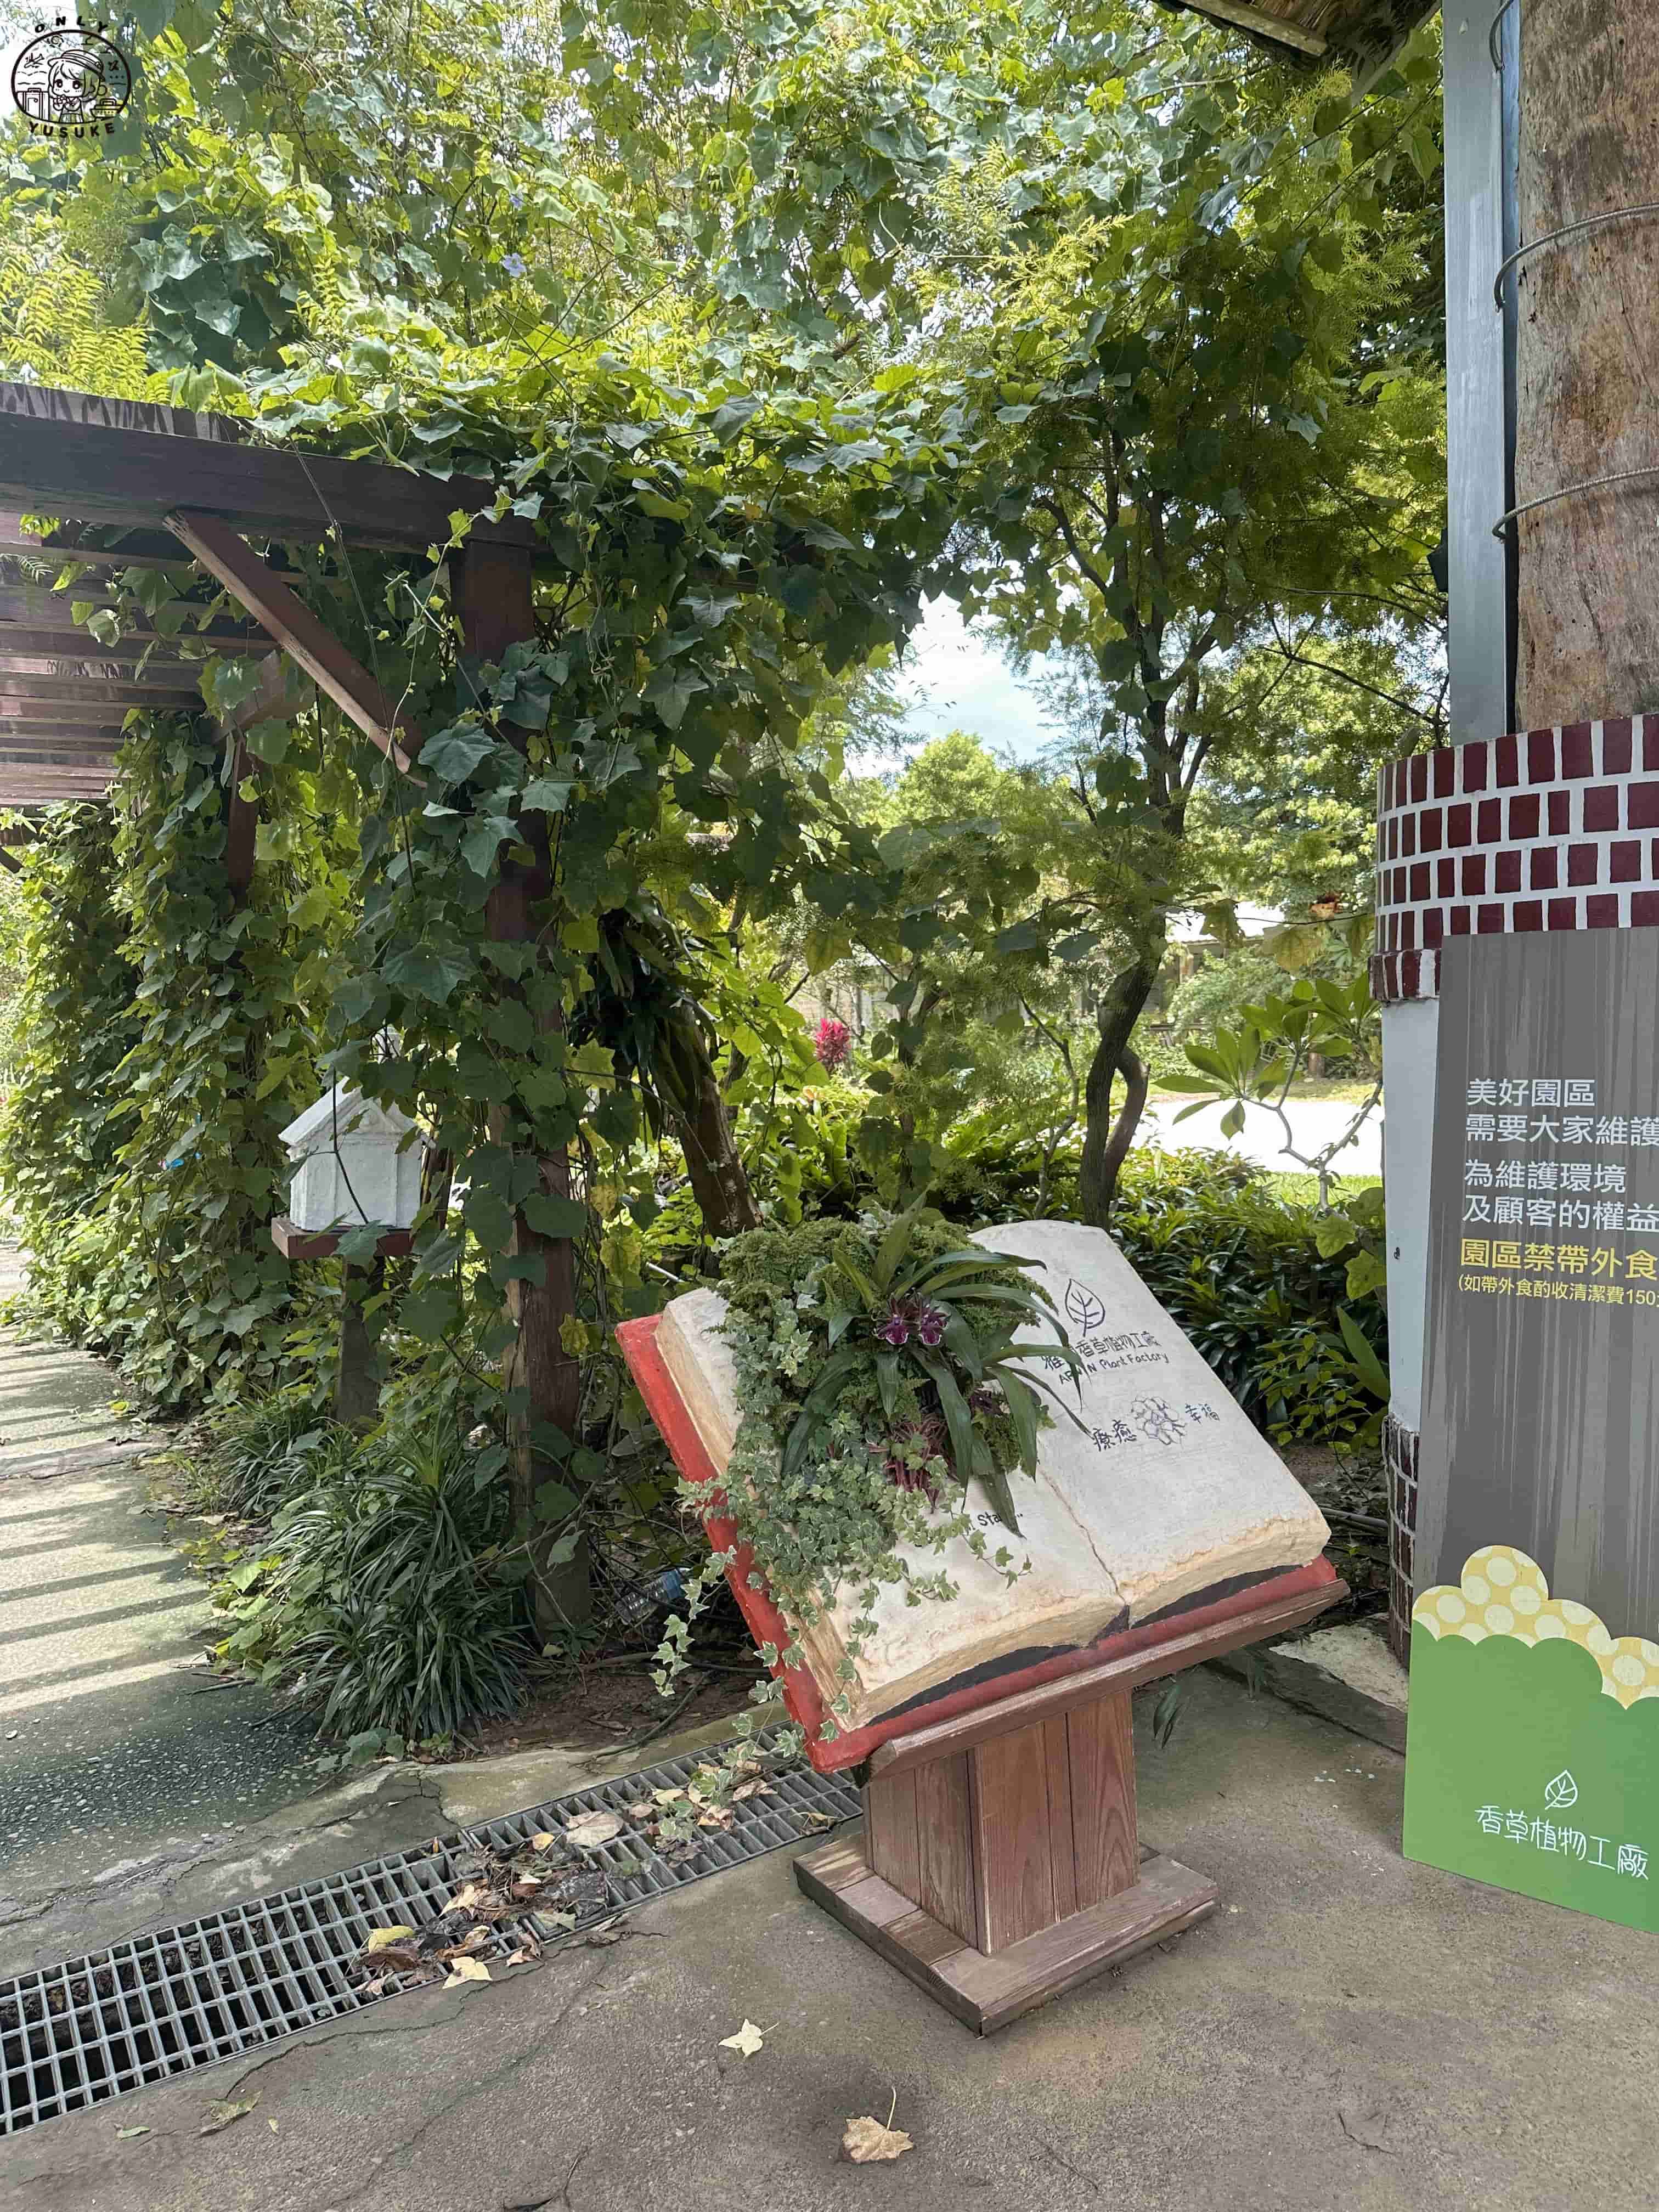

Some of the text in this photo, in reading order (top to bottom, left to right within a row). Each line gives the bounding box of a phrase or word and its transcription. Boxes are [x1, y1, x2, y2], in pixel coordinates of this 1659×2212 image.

[1466, 1077, 1596, 1108] 美好園區
[1465, 1113, 1659, 1147] 需要大家維護
[1464, 1159, 1627, 1193] 為維護環境
[1462, 1194, 1659, 1233] 及顧客的權益
[1460, 1238, 1658, 1282] 園區禁帶外食
[1458, 1273, 1659, 1308] (如帶外食酌收清潔費150
[1099, 1356, 1128, 1370] Plant
[1126, 1351, 1170, 1364] Factory
[1474, 1804, 1649, 1880] 香草植物工廠
